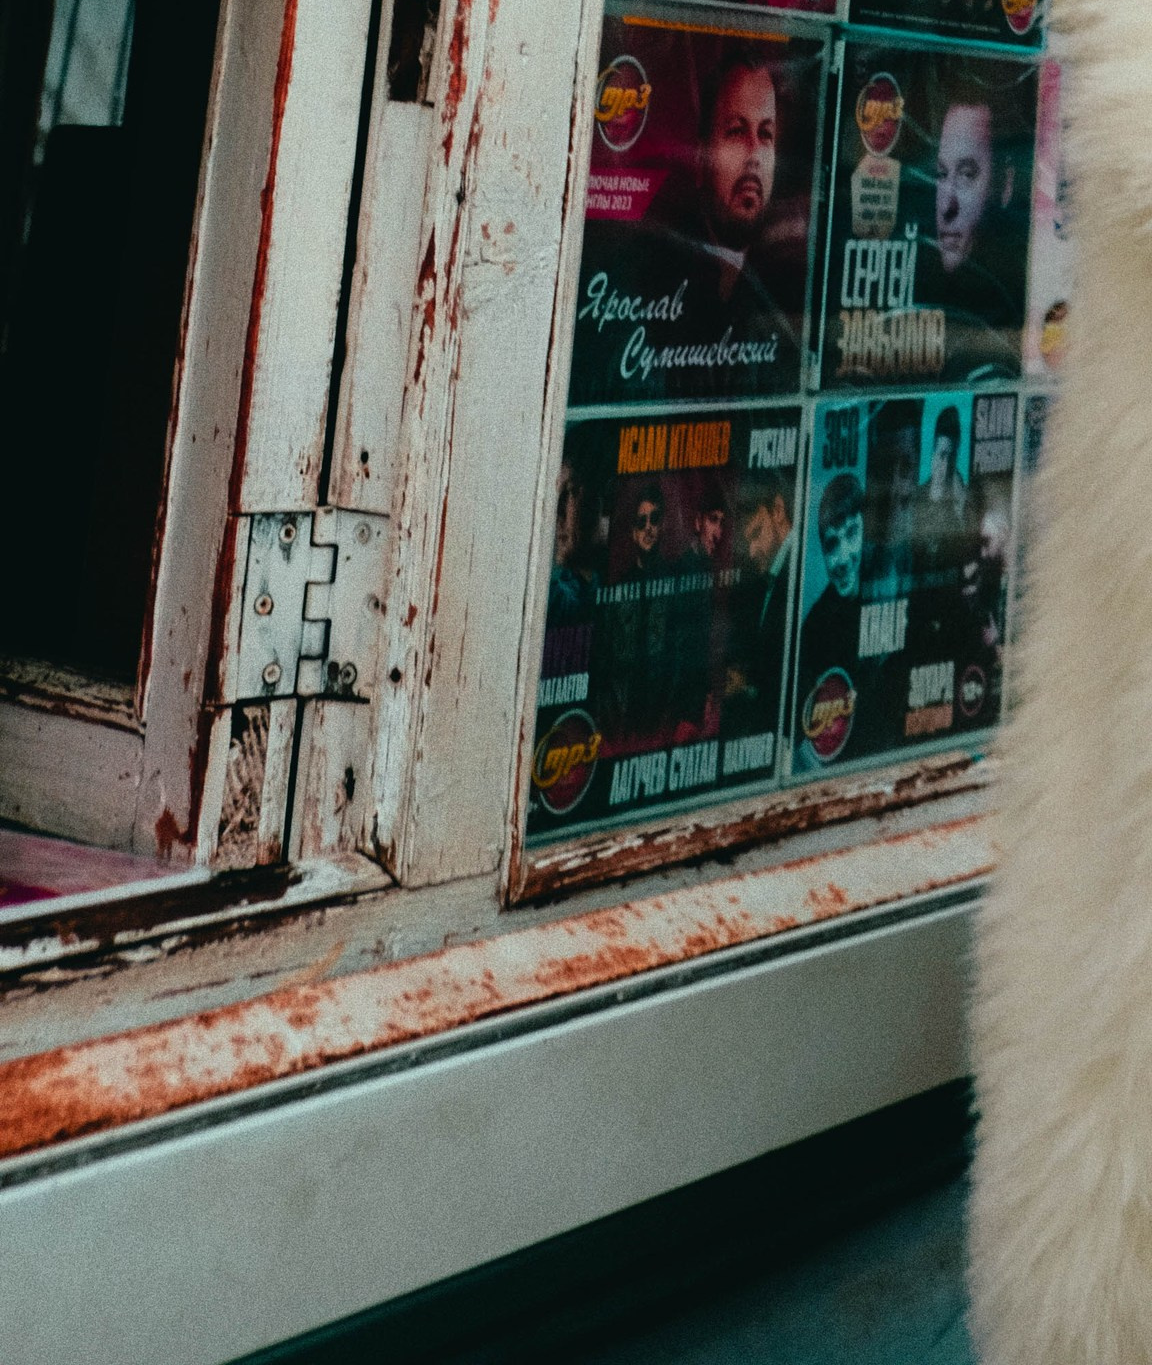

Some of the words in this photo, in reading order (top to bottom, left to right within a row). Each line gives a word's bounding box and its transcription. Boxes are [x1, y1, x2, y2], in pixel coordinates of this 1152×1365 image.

[595, 82, 652, 122] mp3
[841, 223, 918, 310] СЕРГЕЙ
[579, 271, 688, 332] Ярослав
[620, 325, 780, 380] Сумишевский
[534, 732, 602, 787] mp3
